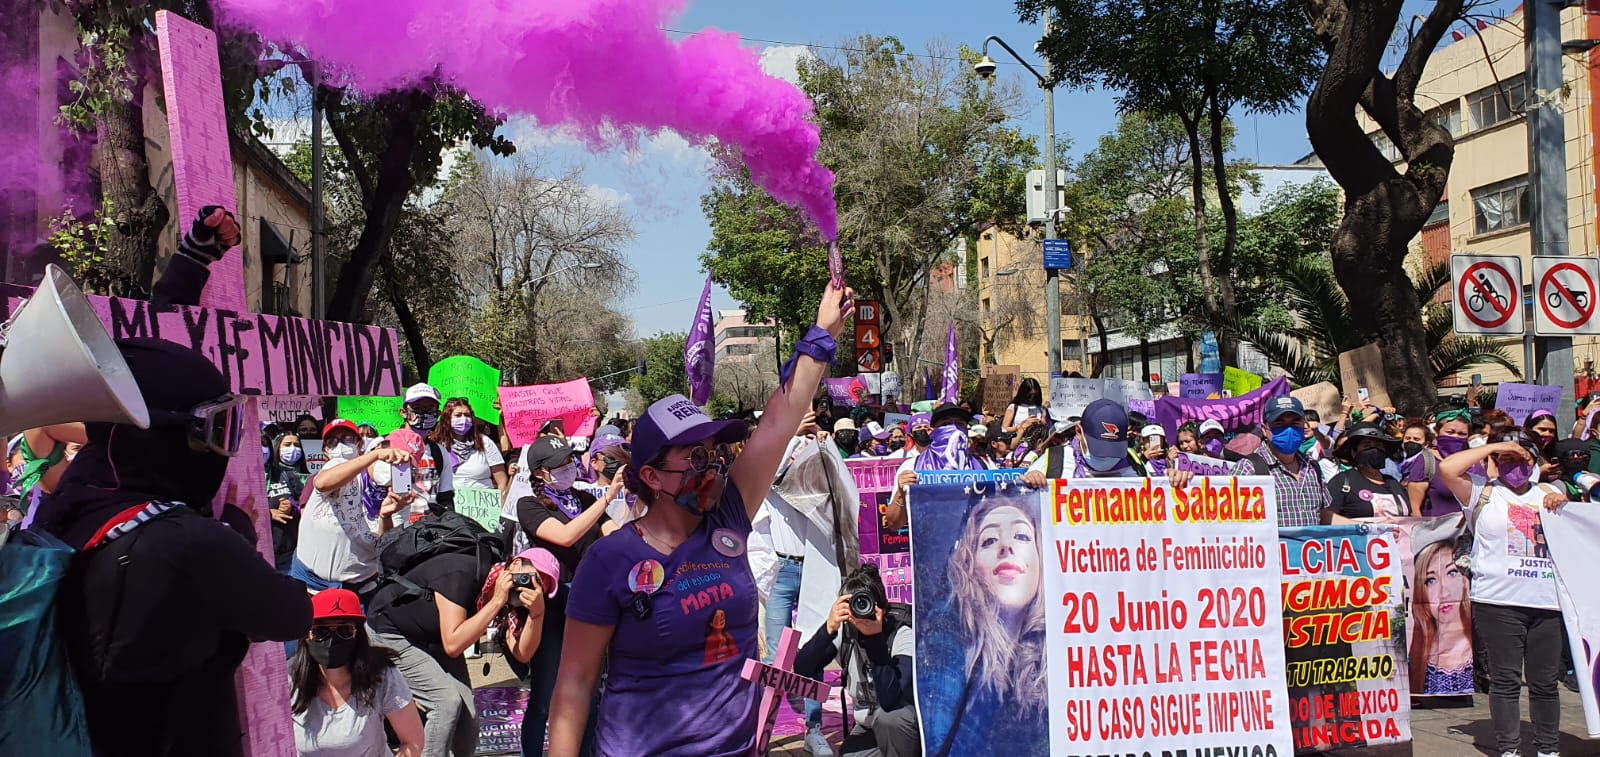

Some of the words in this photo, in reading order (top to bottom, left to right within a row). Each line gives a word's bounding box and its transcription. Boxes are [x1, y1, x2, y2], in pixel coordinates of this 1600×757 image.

[216, 309, 401, 397] FEMINICIDA
[861, 329, 875, 345] 4
[1053, 478, 1167, 524] Fernanda
[1172, 477, 1266, 523] Sabalza
[1056, 539, 1130, 573] Victima
[1136, 540, 1157, 571] de
[1162, 536, 1265, 570] Feminicidio
[1366, 538, 1391, 571] G
[1508, 568, 1538, 579] PARA
[680, 582, 735, 616] MATA
[1063, 592, 1099, 633] 20
[1110, 590, 1187, 632] Junio
[1198, 587, 1265, 628] 2020
[1068, 643, 1152, 688] HASTA
[1155, 641, 1183, 683] LA
[1190, 638, 1266, 681] FECHA
[1287, 661, 1311, 687] TU
[1313, 655, 1393, 685] TRABAJO
[757, 664, 821, 702] RENATA
[1067, 699, 1091, 741] SU
[1098, 696, 1145, 741] CASO
[1150, 694, 1202, 738] SIGUE
[1208, 690, 1274, 733] IMPUNE
[1316, 695, 1335, 720] DE
[1339, 688, 1399, 718] MEXICO
